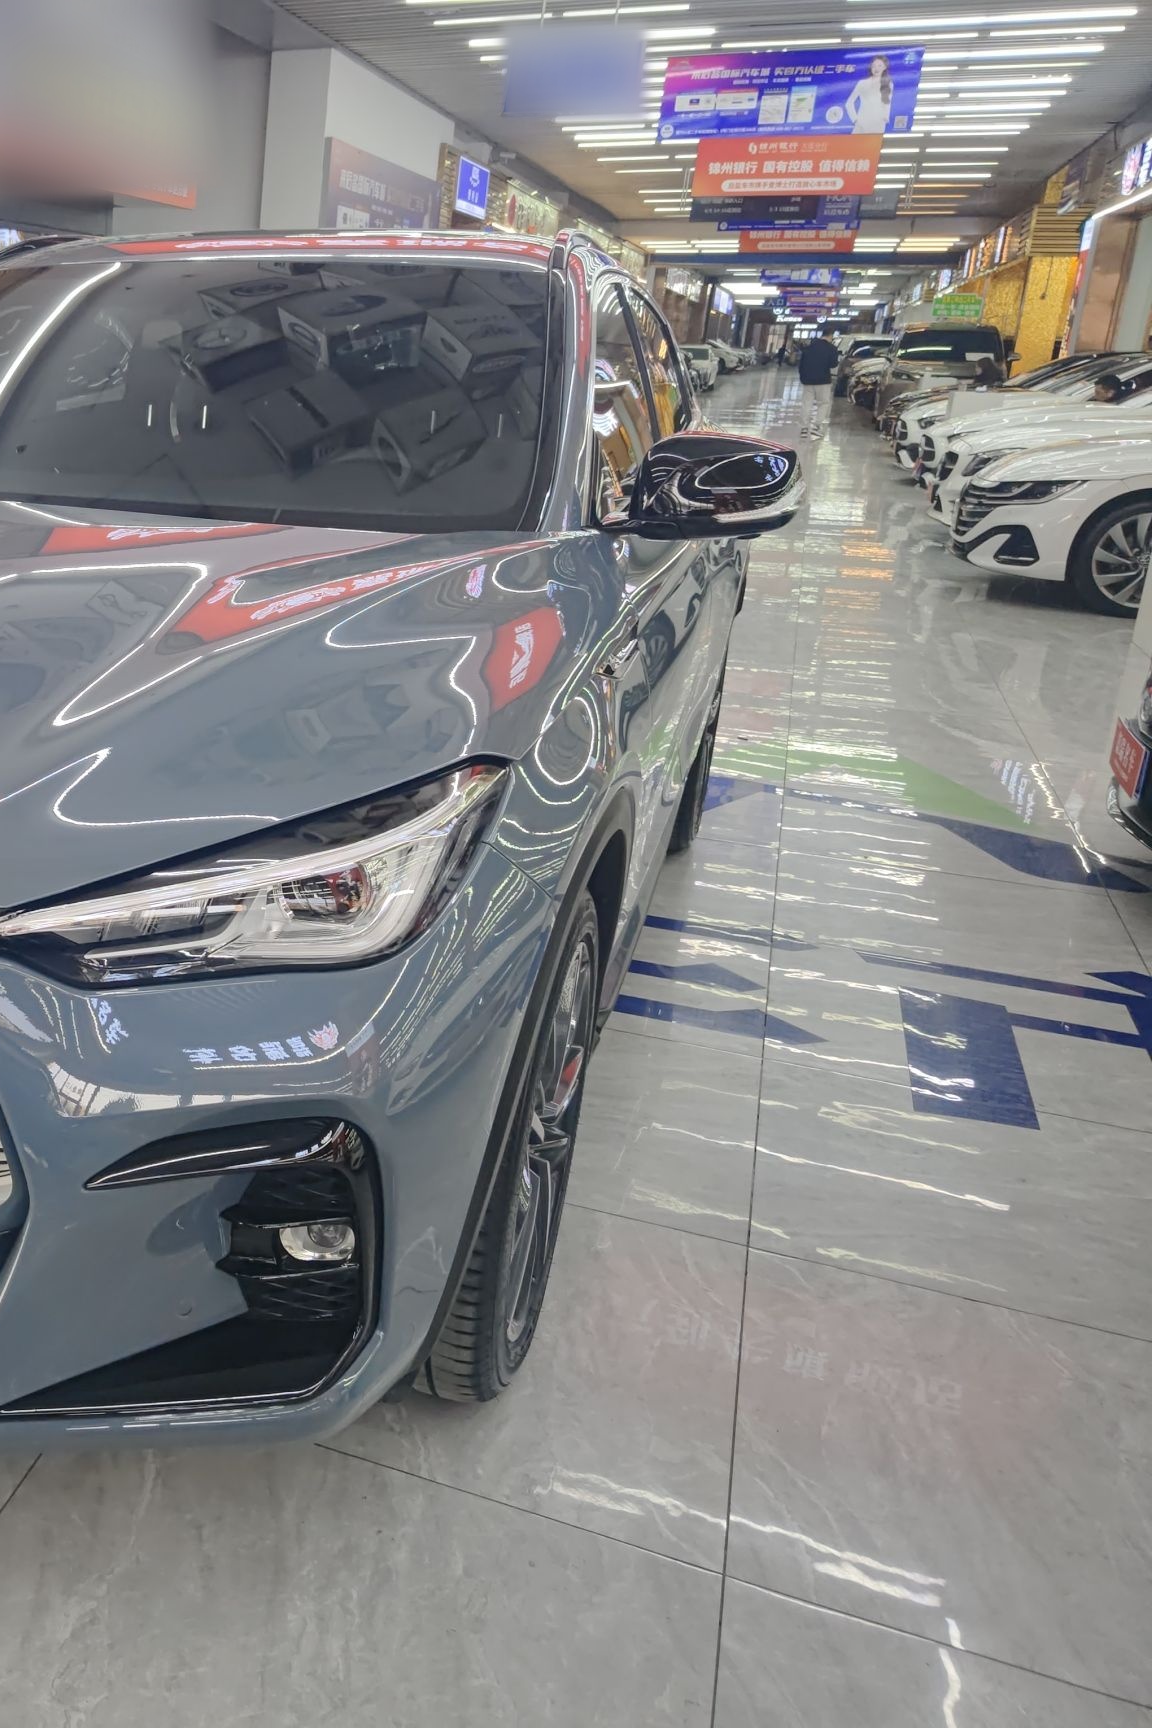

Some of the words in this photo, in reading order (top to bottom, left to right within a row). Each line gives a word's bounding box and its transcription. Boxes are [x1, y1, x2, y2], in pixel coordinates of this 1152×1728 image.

[708, 162, 758, 175] 锦州银行
[762, 160, 814, 173] 国有控股
[819, 159, 871, 172] 值得信赖
